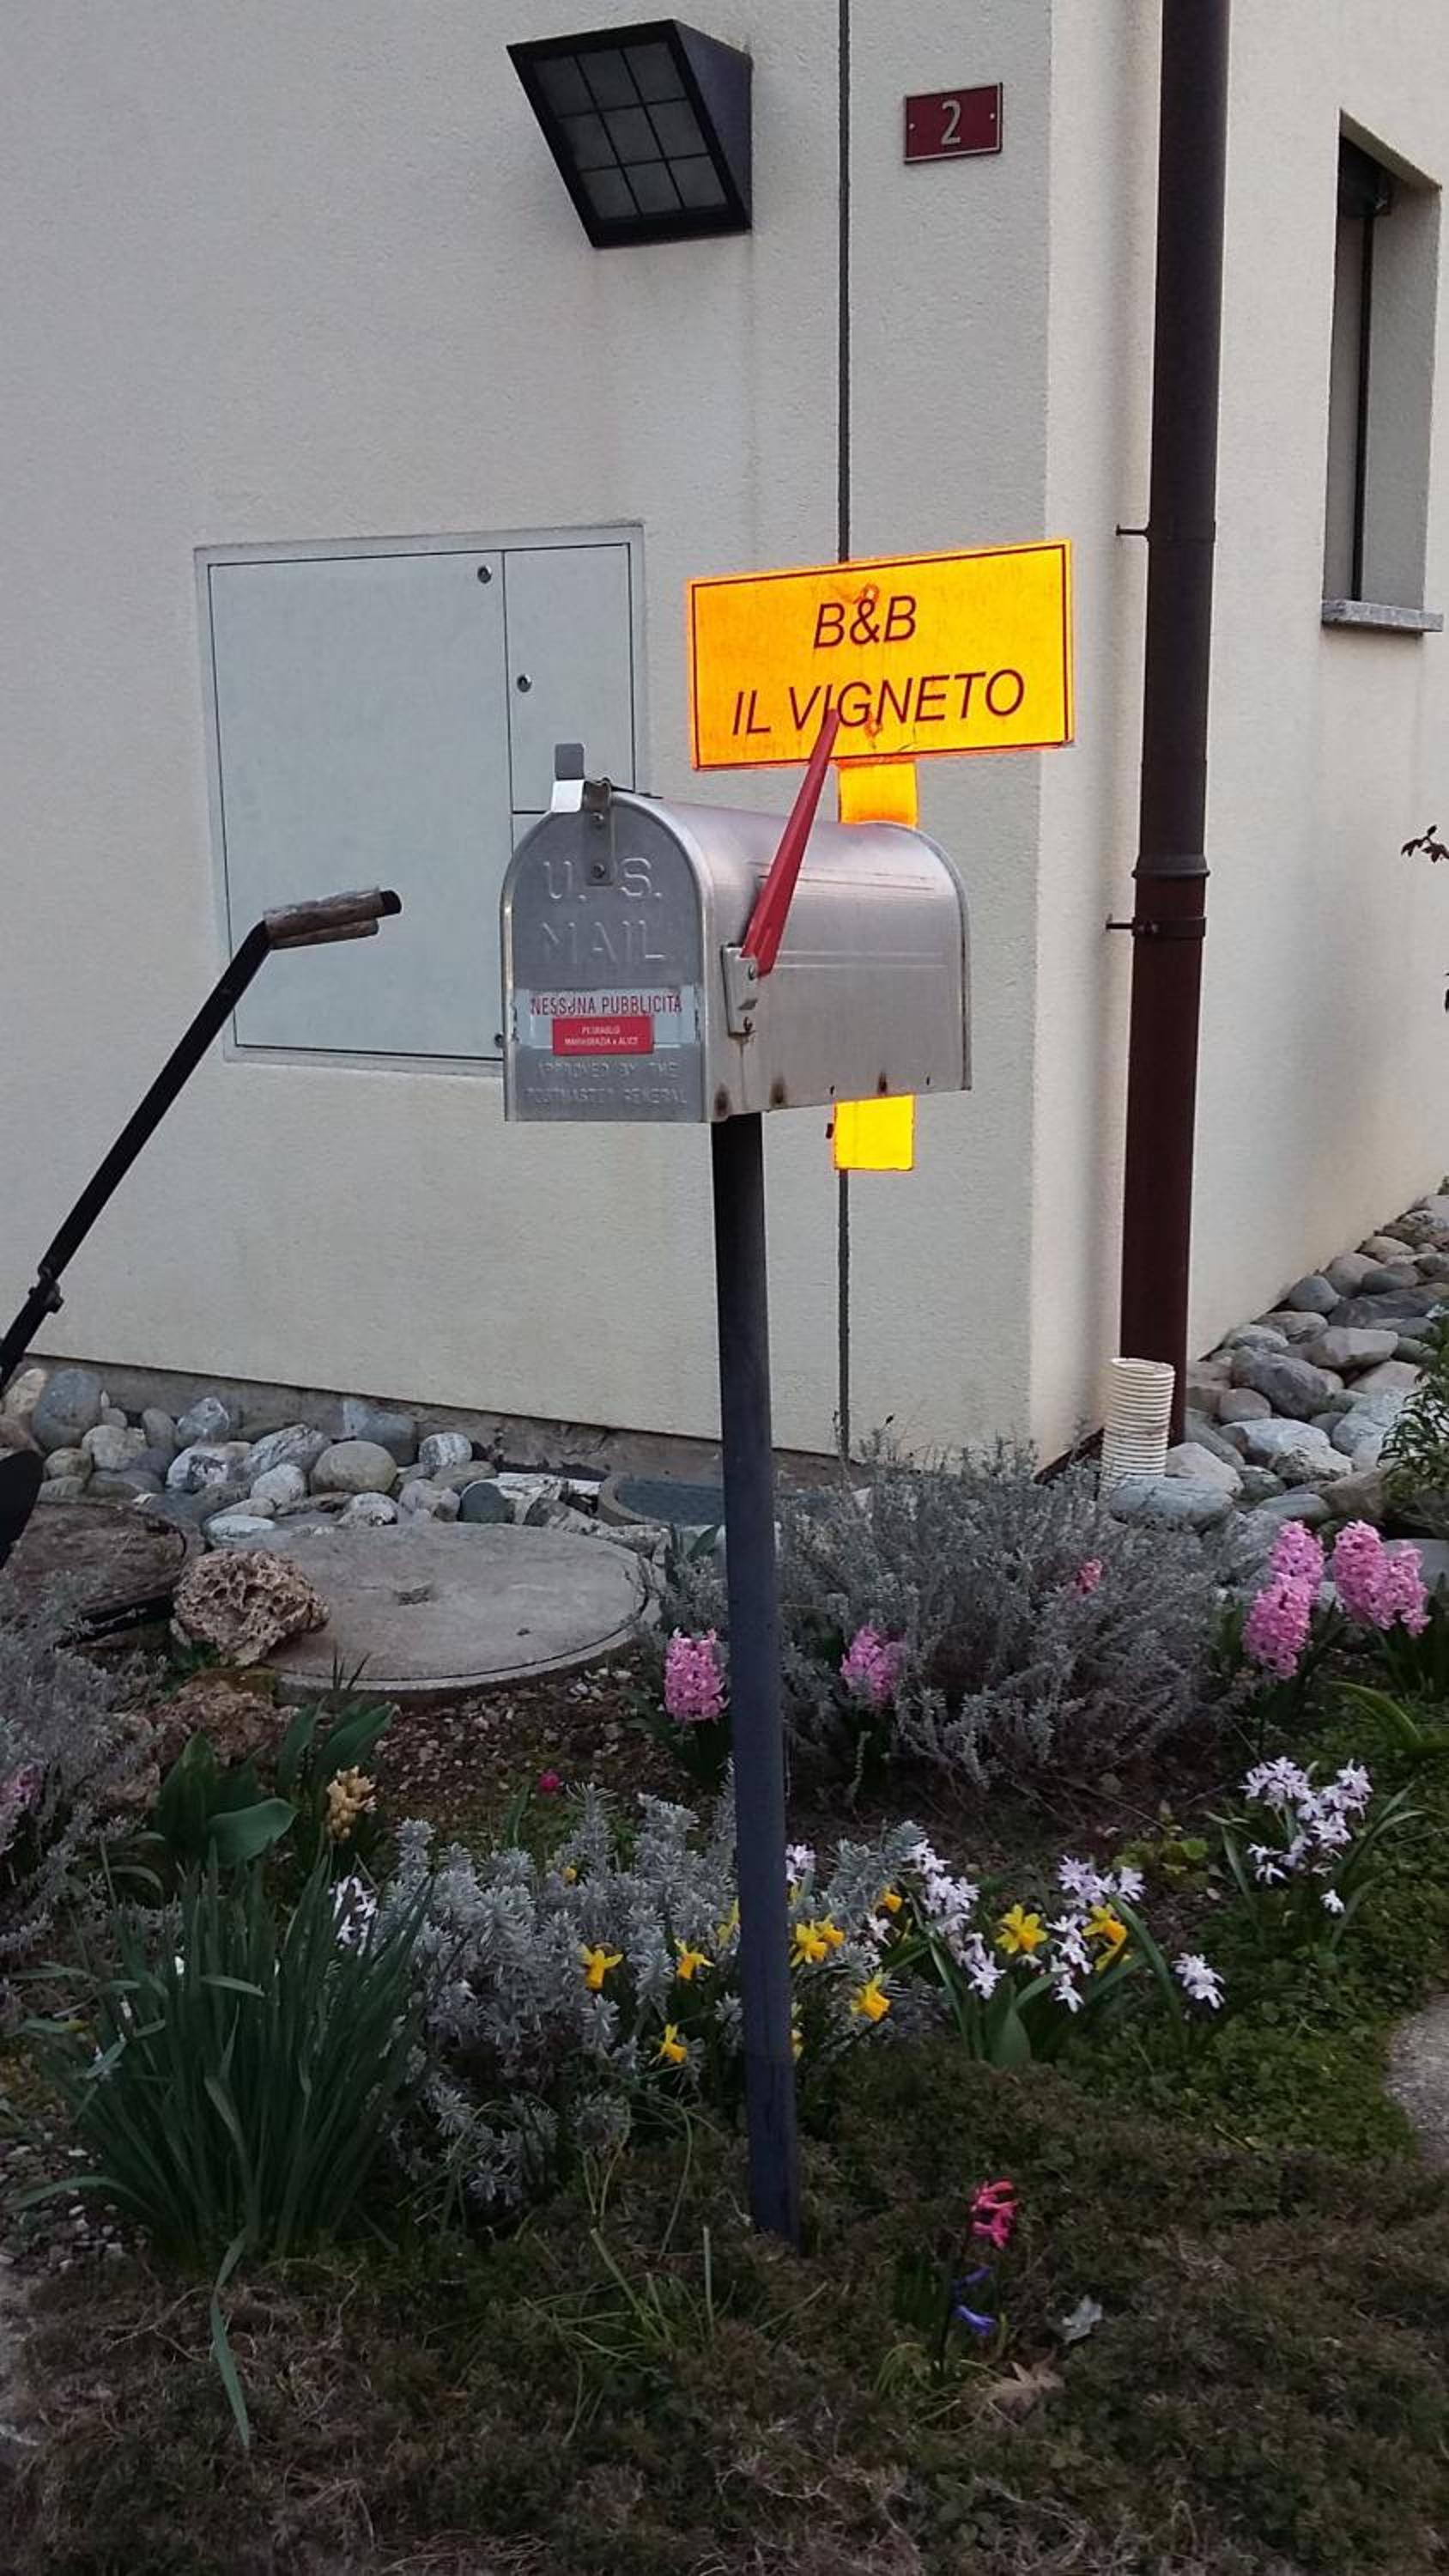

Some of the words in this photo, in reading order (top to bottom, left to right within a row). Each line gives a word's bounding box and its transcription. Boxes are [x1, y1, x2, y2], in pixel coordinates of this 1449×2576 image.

[942, 100, 961, 144] 2
[814, 596, 917, 649] B&B
[732, 690, 771, 735] IL
[789, 669, 1025, 731] VIGNETO
[542, 920, 666, 963] MAIL
[530, 996, 595, 1016] NESSUNA
